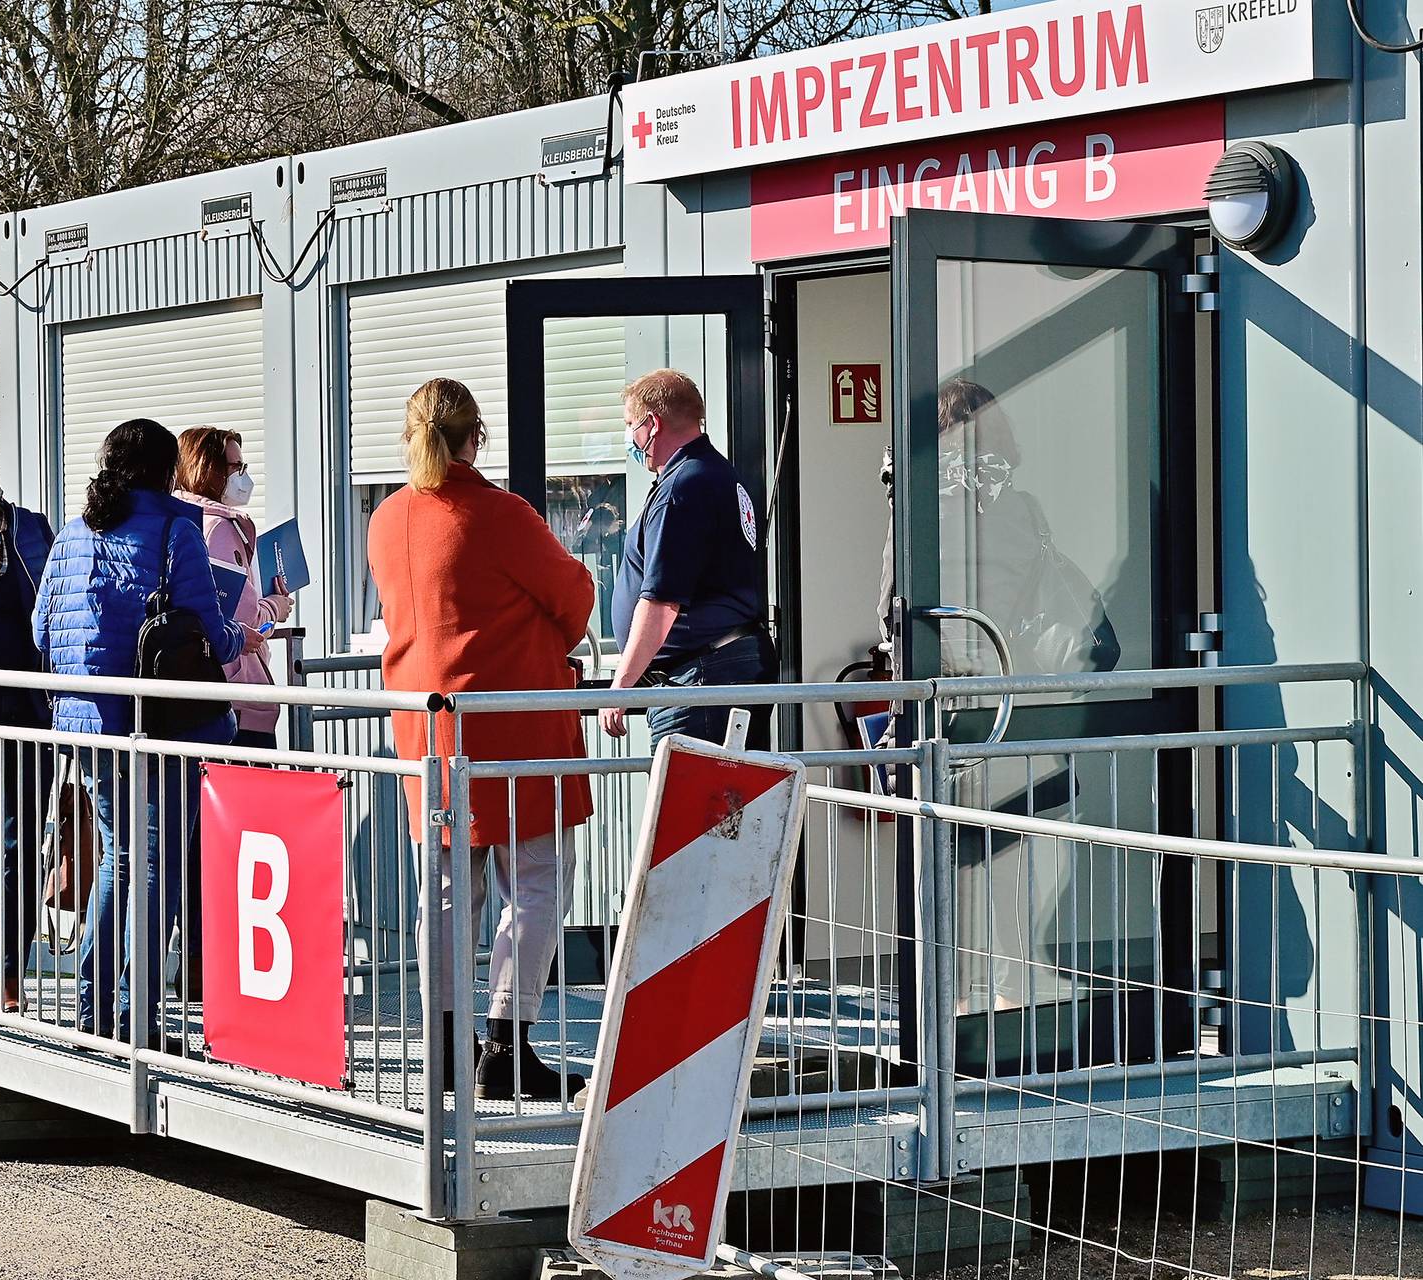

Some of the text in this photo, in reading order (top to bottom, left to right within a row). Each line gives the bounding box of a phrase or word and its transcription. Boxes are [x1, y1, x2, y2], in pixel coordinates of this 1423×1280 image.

[1227, 0, 1296, 23] KREFELD
[730, 5, 1148, 149] IMPFZENTRUM
[656, 104, 696, 119] Deutsches
[656, 121, 678, 132] Rotes
[656, 135, 678, 145] Kreuz
[543, 146, 594, 166] KLEUSBERG
[833, 133, 1117, 234] EINGANG B
[204, 208, 241, 224] KLEUSBERG
[237, 829, 293, 1001] B
[647, 1226, 694, 1241] Fachbereich
